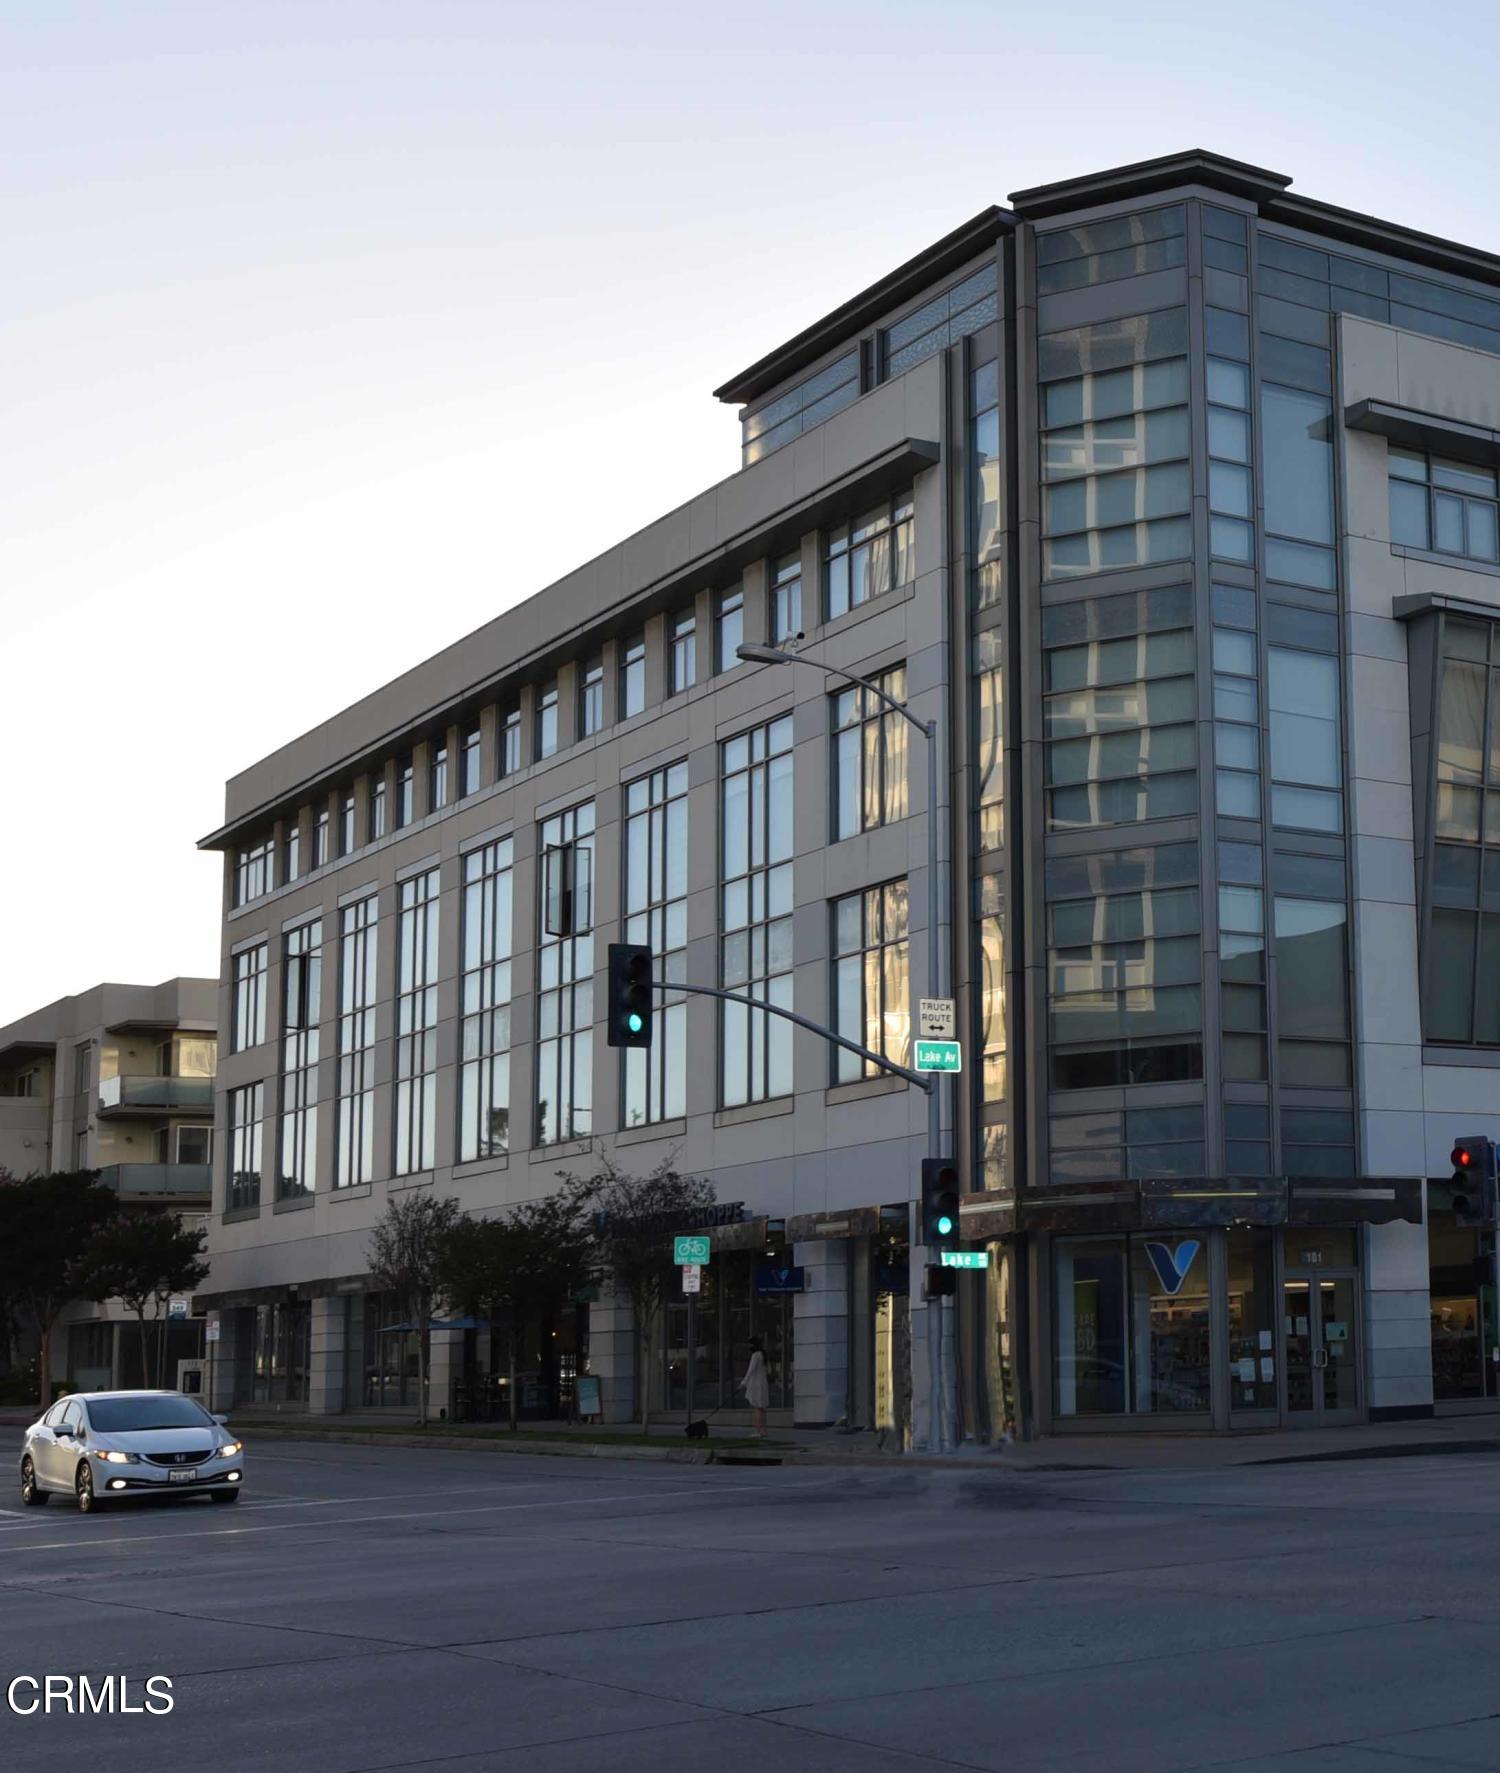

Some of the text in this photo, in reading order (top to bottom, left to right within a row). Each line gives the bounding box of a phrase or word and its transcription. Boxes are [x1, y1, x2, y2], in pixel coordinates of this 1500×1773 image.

[921, 1002, 952, 1011] TRUCK
[921, 1013, 952, 1022] ROUTE
[919, 1050, 957, 1063] Lake Av
[941, 1251, 971, 1267] Lake
